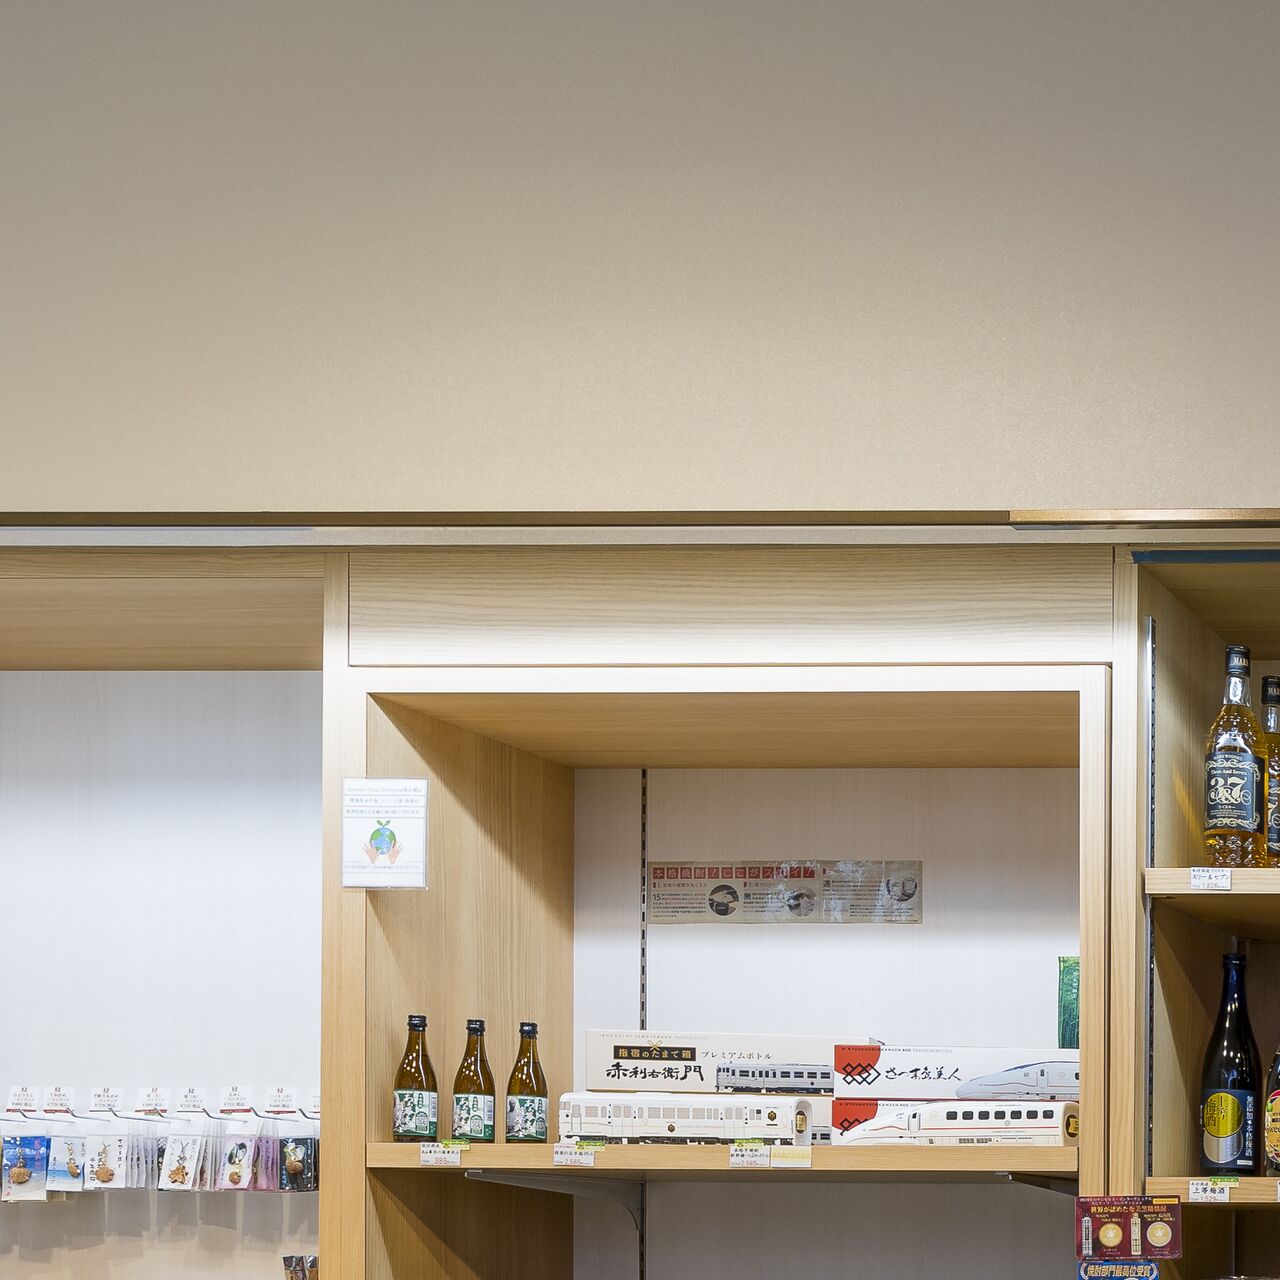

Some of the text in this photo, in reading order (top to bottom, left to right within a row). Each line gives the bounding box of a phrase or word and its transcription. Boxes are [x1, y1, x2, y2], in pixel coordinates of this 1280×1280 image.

[618, 1048, 692, 1060] 指宿のたまて箱
[701, 1048, 773, 1062] プレミアムボトル
[606, 1061, 705, 1082] 赤利右衛門
[1087, 1265, 1151, 1278] 焼酎部門最高位受賞
